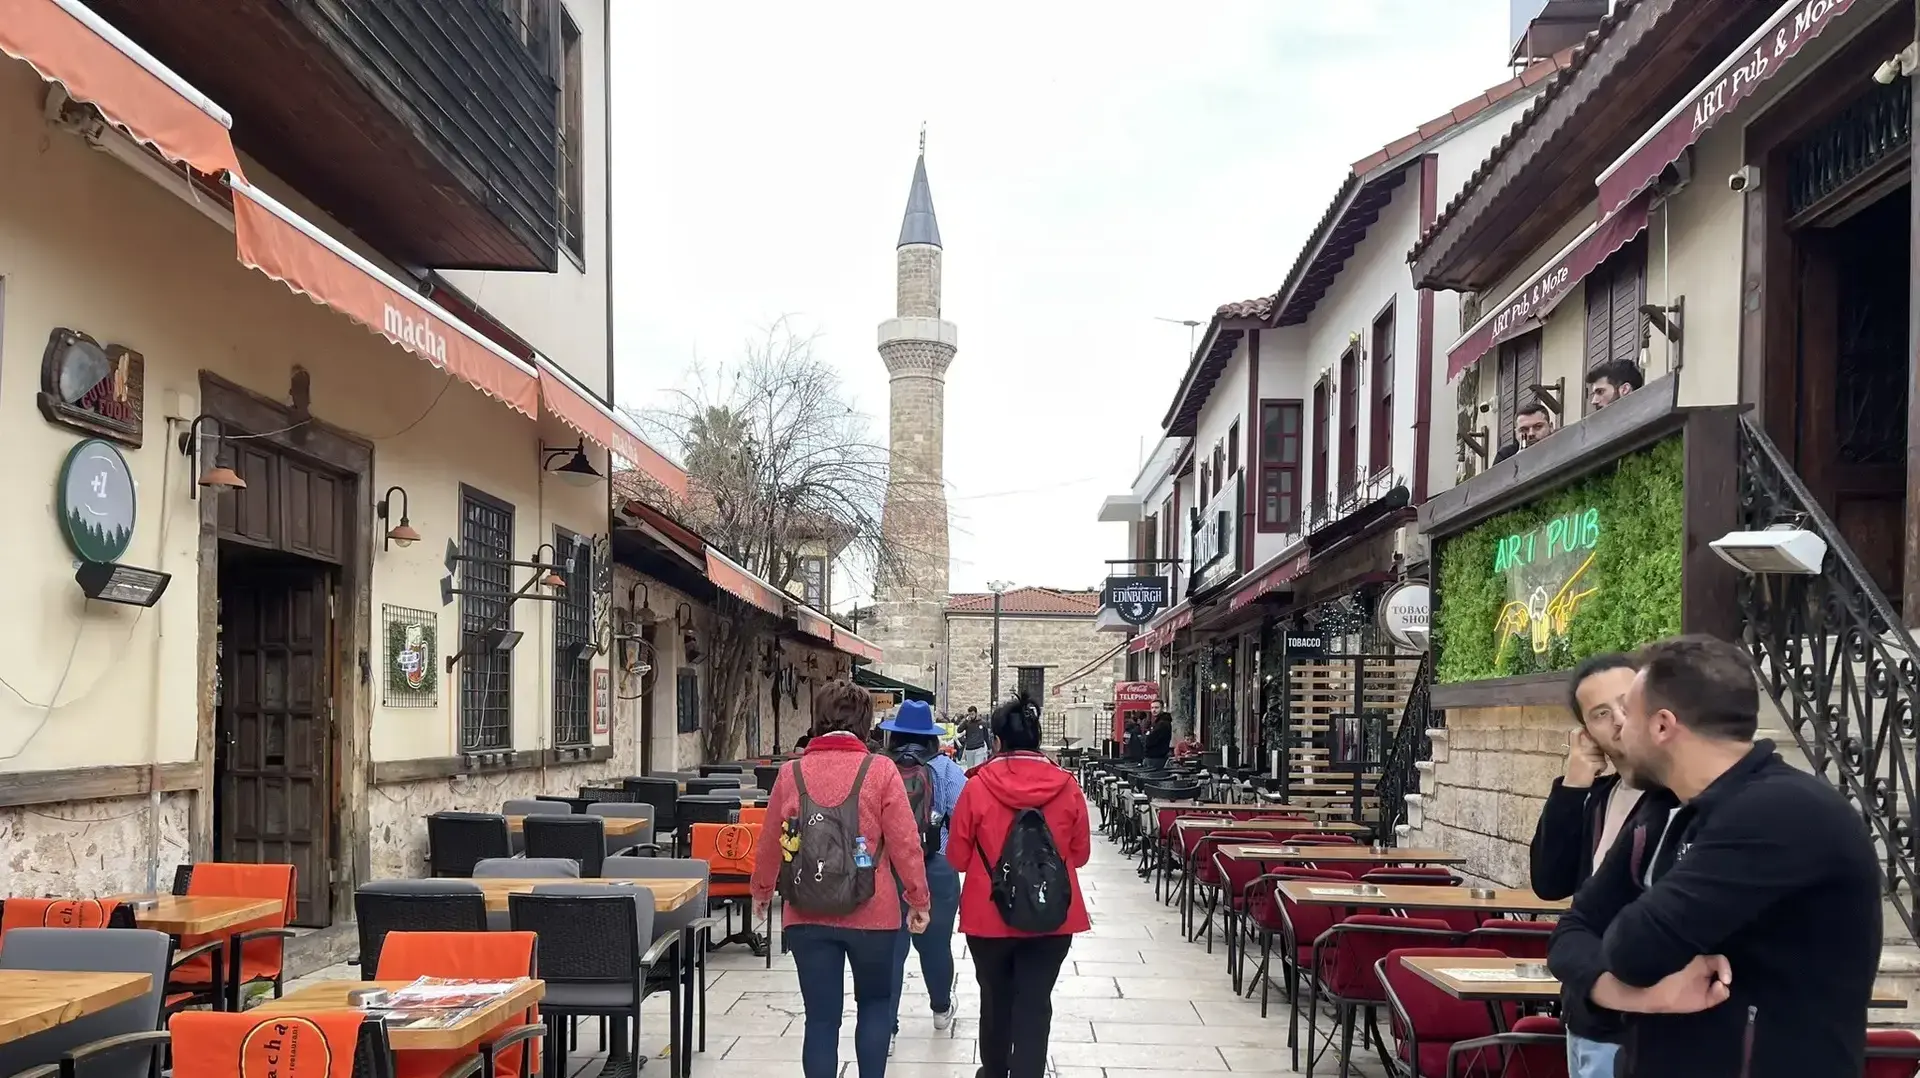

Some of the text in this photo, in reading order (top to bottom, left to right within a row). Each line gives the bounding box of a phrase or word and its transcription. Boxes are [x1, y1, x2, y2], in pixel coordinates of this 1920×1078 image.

[1690, 78, 1727, 133] ART
[1732, 46, 1769, 96] Pub
[1774, 28, 1788, 57] &
[1491, 266, 1569, 339] ART Pub & More
[385, 303, 447, 364] macha
[1495, 508, 1599, 573] ART PUB
[1112, 590, 1162, 603] EDINBURGH
[1392, 605, 1429, 615] TOBAC
[1288, 637, 1321, 648] TOBACCO
